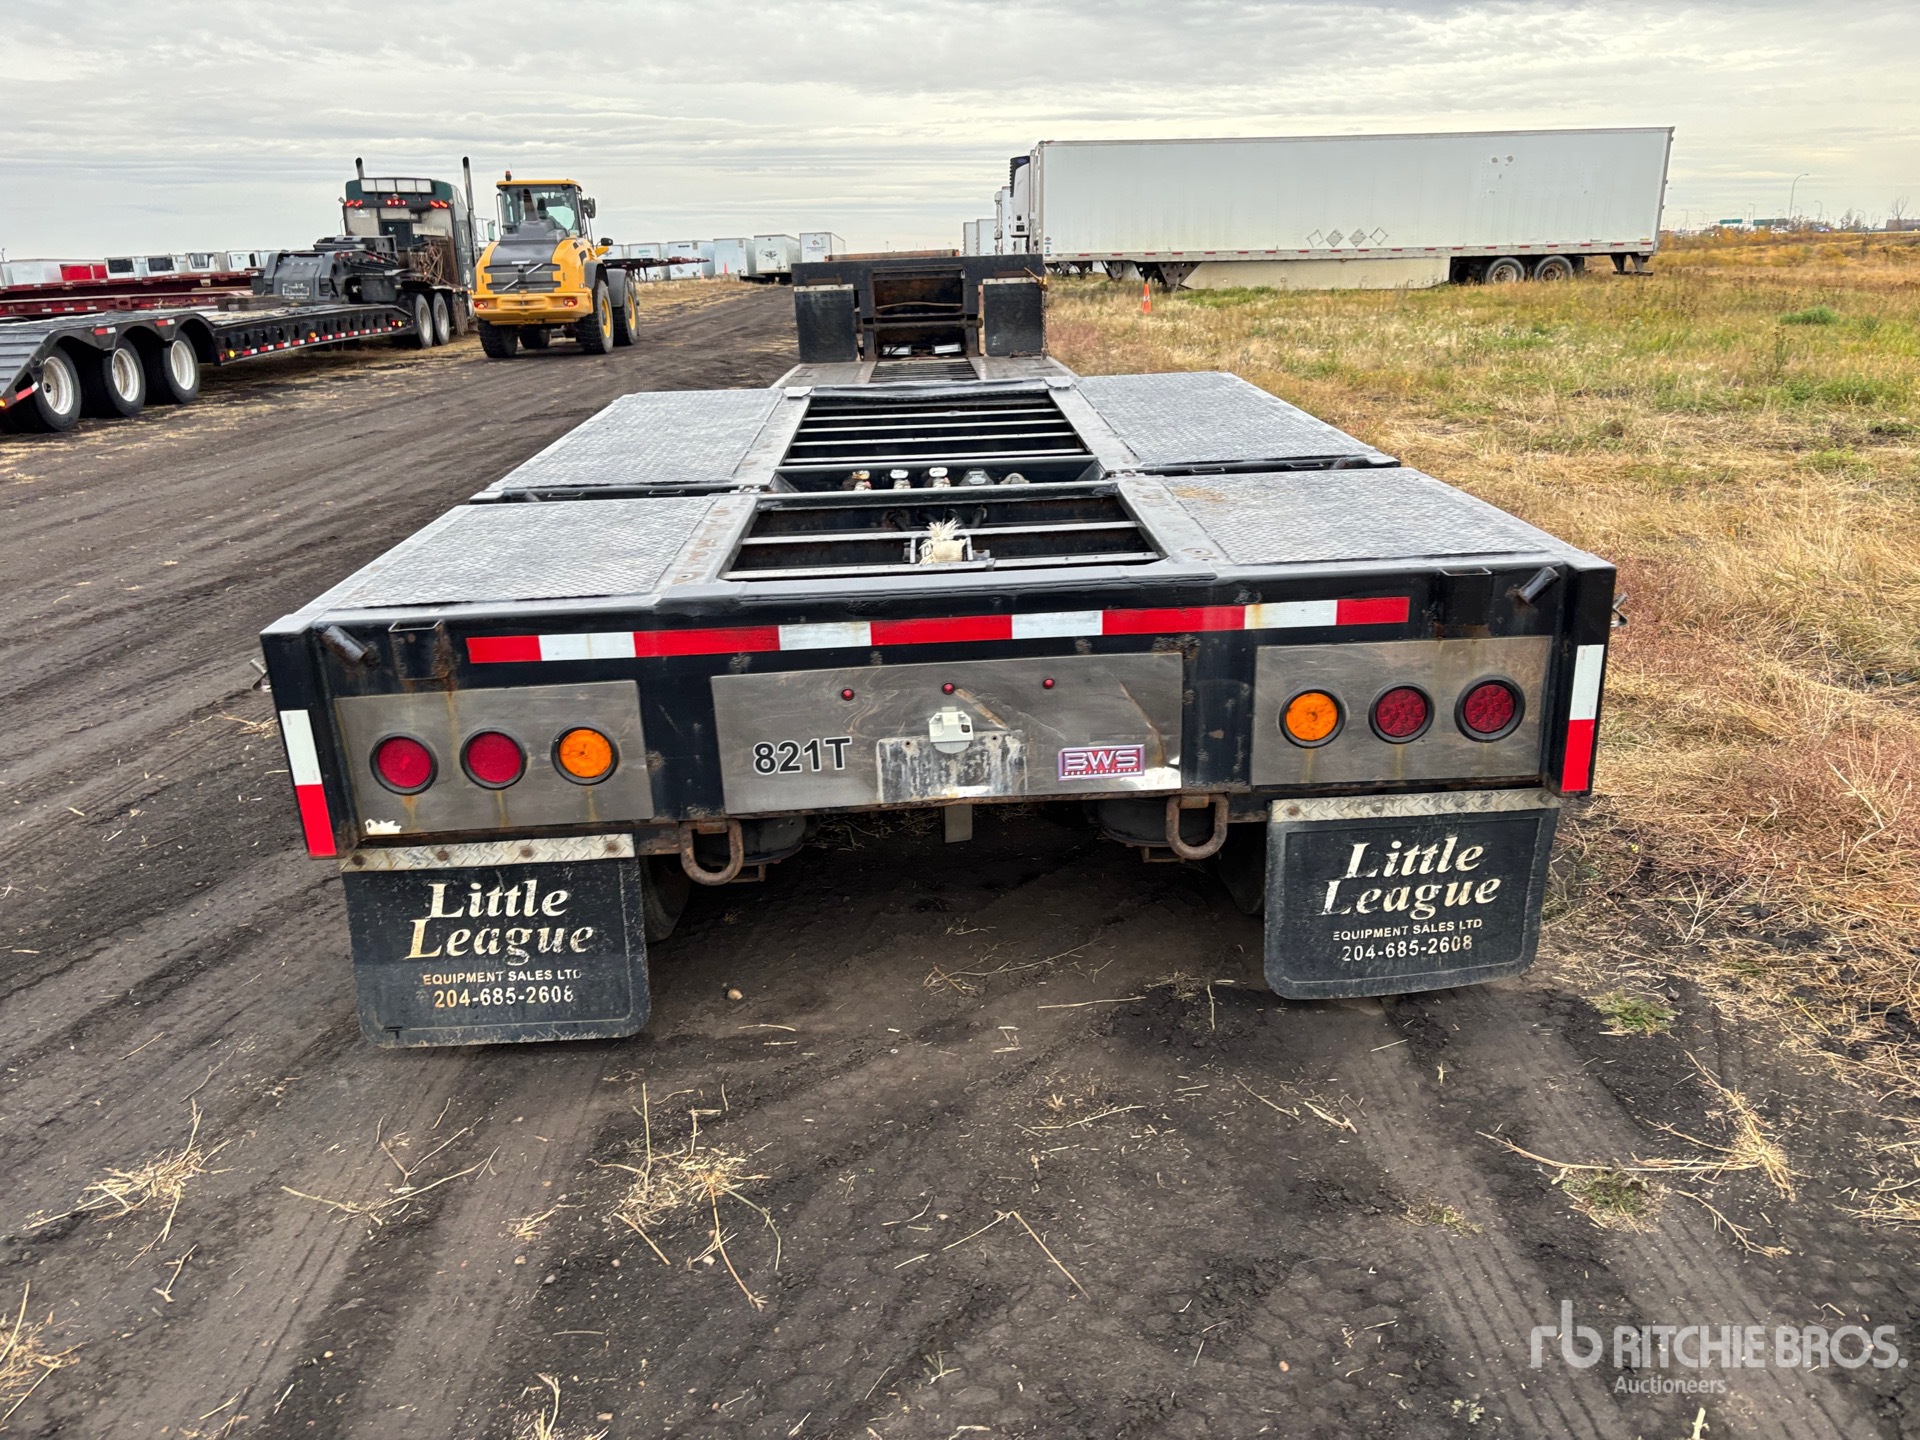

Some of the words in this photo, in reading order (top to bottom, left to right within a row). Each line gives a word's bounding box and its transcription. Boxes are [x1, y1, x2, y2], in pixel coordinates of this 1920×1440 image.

[753, 736, 852, 775] 821T
[1064, 750, 1138, 771] BWS
[1342, 836, 1484, 879] Little
[425, 879, 569, 919] Little
[1320, 877, 1502, 921] League
[403, 918, 595, 966] League
[1333, 925, 1409, 941] EQUIPMENT
[1413, 921, 1455, 935] SALES
[1342, 935, 1473, 962] 204-685-2608
[423, 971, 505, 986] EQUIPMENT
[508, 969, 553, 982] SALES
[434, 985, 575, 1008] 204-685-2608
